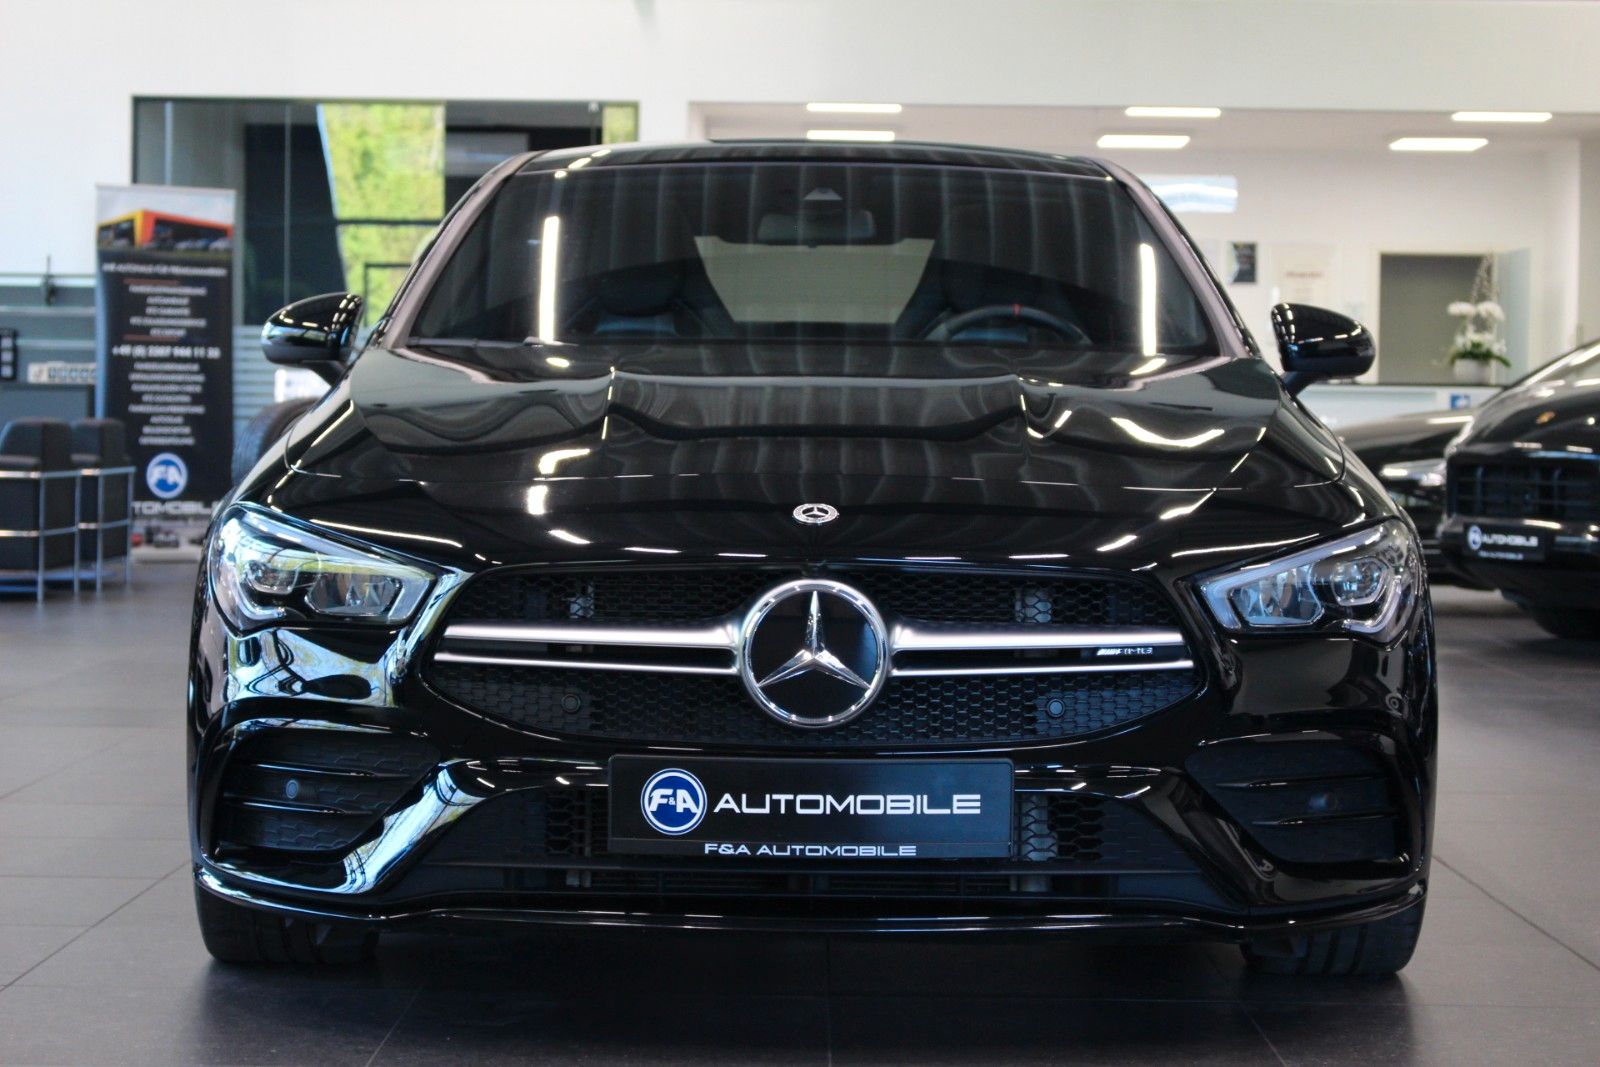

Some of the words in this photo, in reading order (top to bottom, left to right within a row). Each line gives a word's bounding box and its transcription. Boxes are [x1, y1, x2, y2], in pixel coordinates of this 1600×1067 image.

[649, 788, 699, 814] F&A
[713, 793, 981, 815] AUTOMOBILE
[704, 843, 751, 855] F&A
[756, 844, 916, 856] AUTOMOBILE
